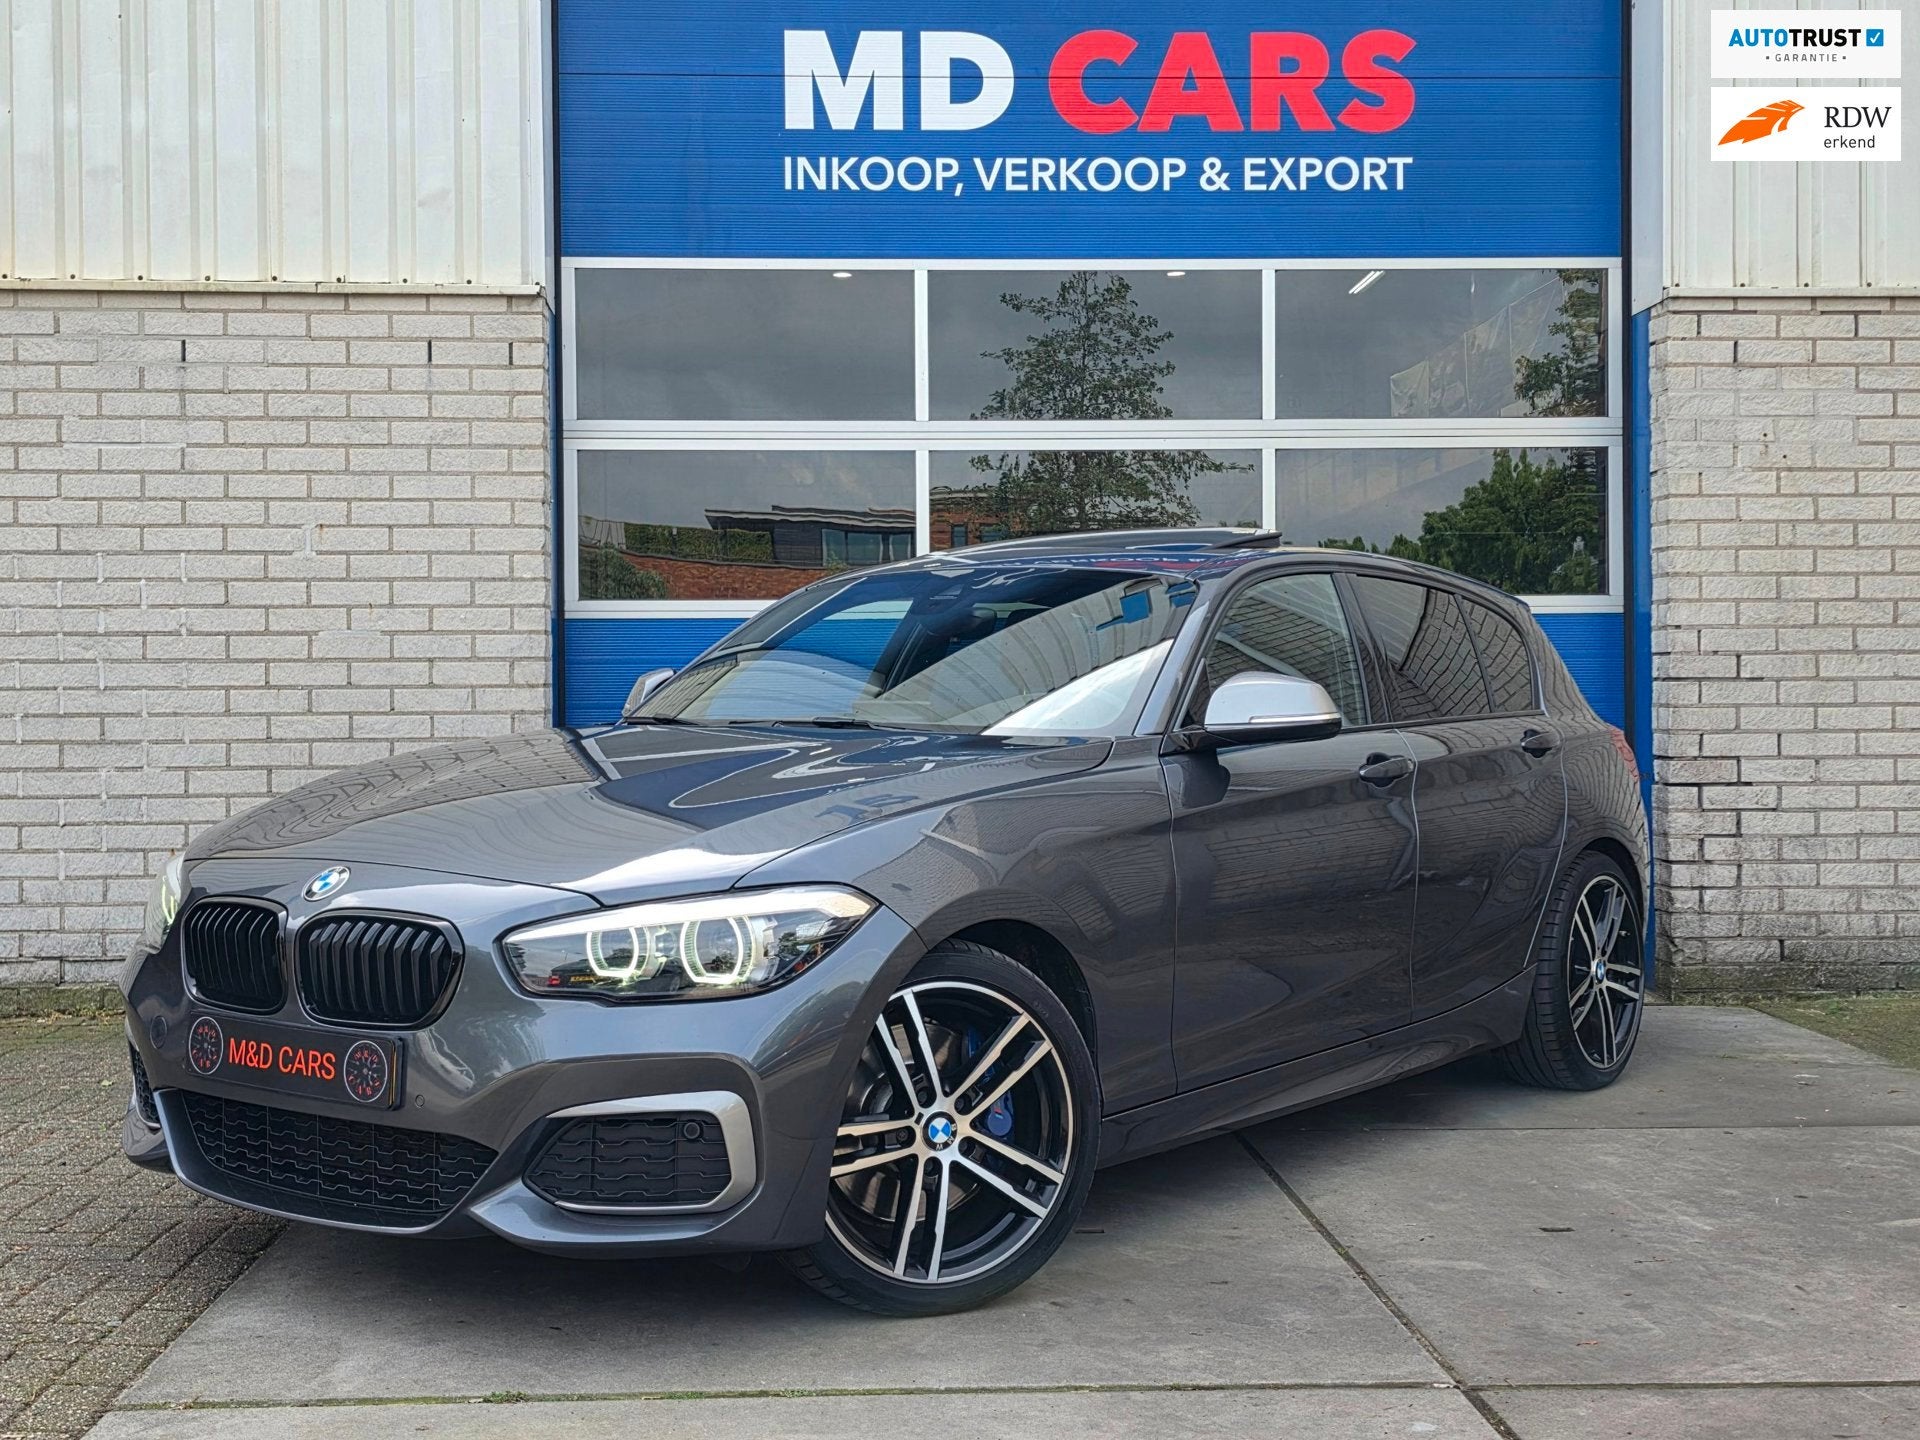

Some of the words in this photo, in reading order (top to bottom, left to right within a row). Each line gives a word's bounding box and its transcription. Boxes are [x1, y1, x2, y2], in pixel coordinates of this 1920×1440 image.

[784, 30, 1014, 131] MD
[1048, 30, 1417, 133] CARS
[784, 156, 963, 197] INKOOP,
[973, 156, 1187, 192] VERKOOP
[1200, 156, 1230, 191] &
[1244, 156, 1413, 191] EXPORT
[229, 1038, 273, 1069] M&D
[278, 1046, 336, 1080] CARS
